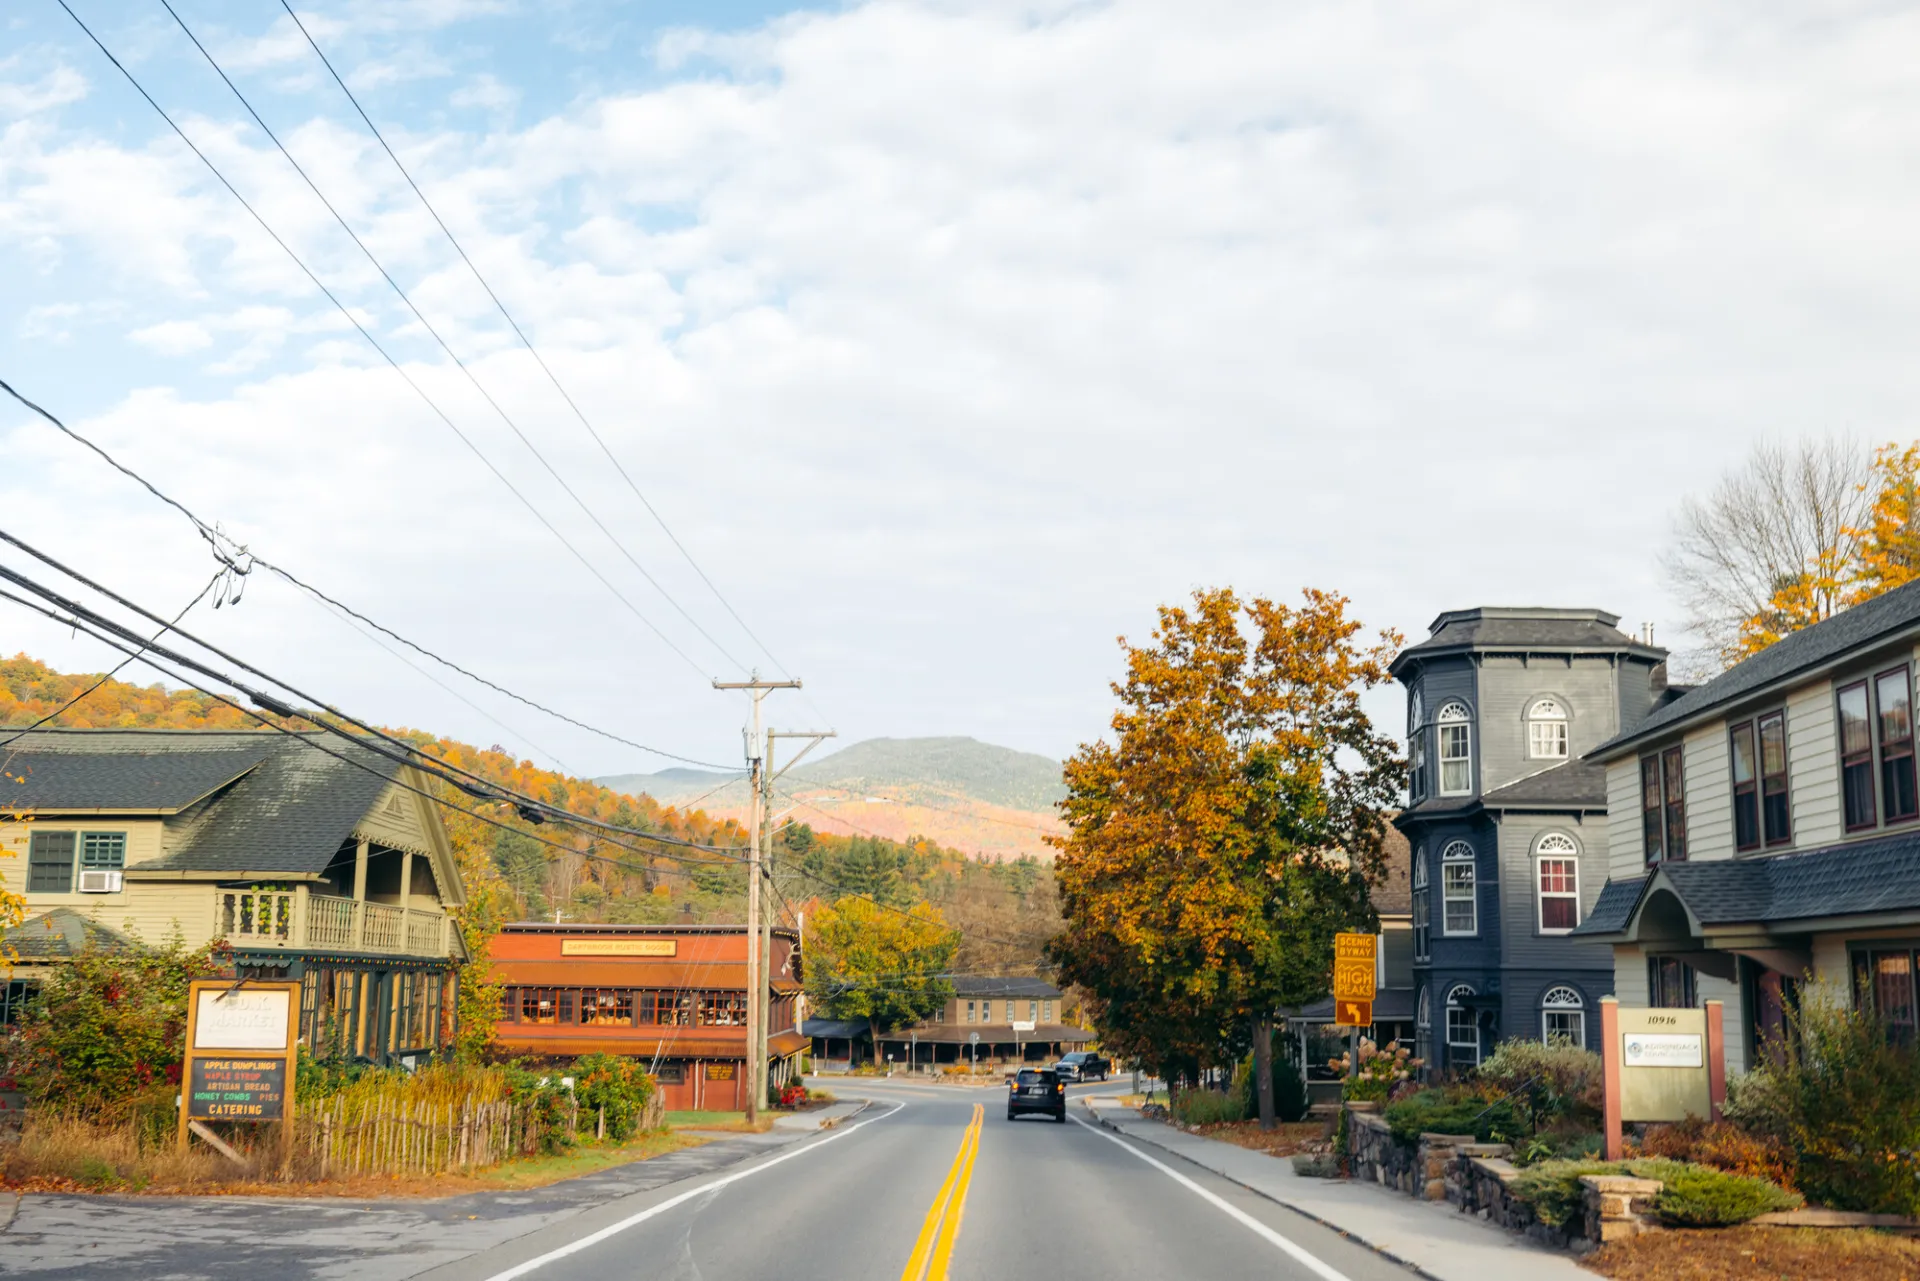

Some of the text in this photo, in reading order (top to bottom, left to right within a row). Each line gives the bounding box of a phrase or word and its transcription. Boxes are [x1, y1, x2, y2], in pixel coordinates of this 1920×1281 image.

[1340, 937, 1372, 947] SCENIC
[1340, 947, 1371, 956] BYWAY
[1338, 971, 1372, 985] HIGH
[1338, 984, 1372, 997] PEAKS
[209, 1012, 278, 1028] MARKET
[1647, 1015, 1677, 1025] 10916
[1644, 1043, 1699, 1051] ADIRONDACK
[204, 1061, 277, 1071] APPLE DUMPLINGS
[204, 1072, 261, 1080] MAPLE SYRUP
[207, 1082, 271, 1091] ARTISAN BREAD
[194, 1092, 280, 1102] HONEY COMBS PIES
[208, 1103, 263, 1115] CATERING
